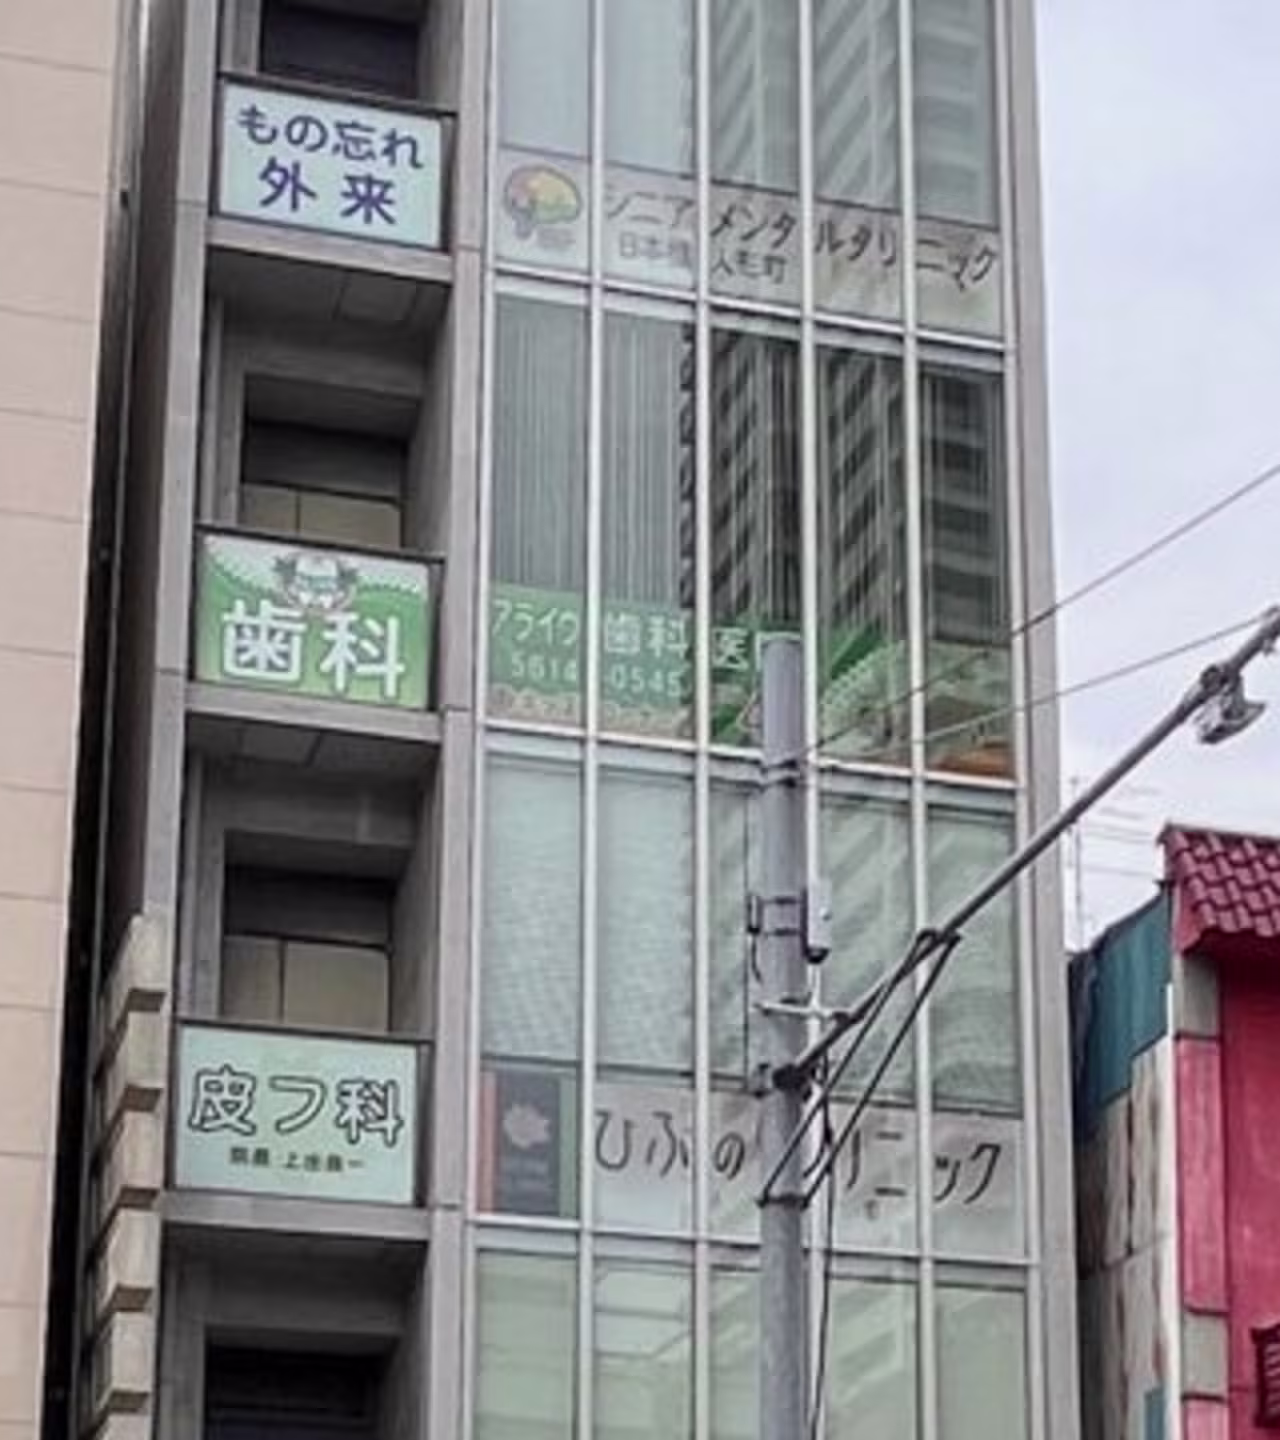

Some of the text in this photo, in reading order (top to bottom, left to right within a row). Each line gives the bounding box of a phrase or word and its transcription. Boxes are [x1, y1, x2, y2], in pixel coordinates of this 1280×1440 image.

[237, 103, 424, 170] もの忘れ
[259, 158, 398, 226] 外来
[220, 598, 406, 700] 歯科
[189, 1064, 404, 1147] 皮フ科
